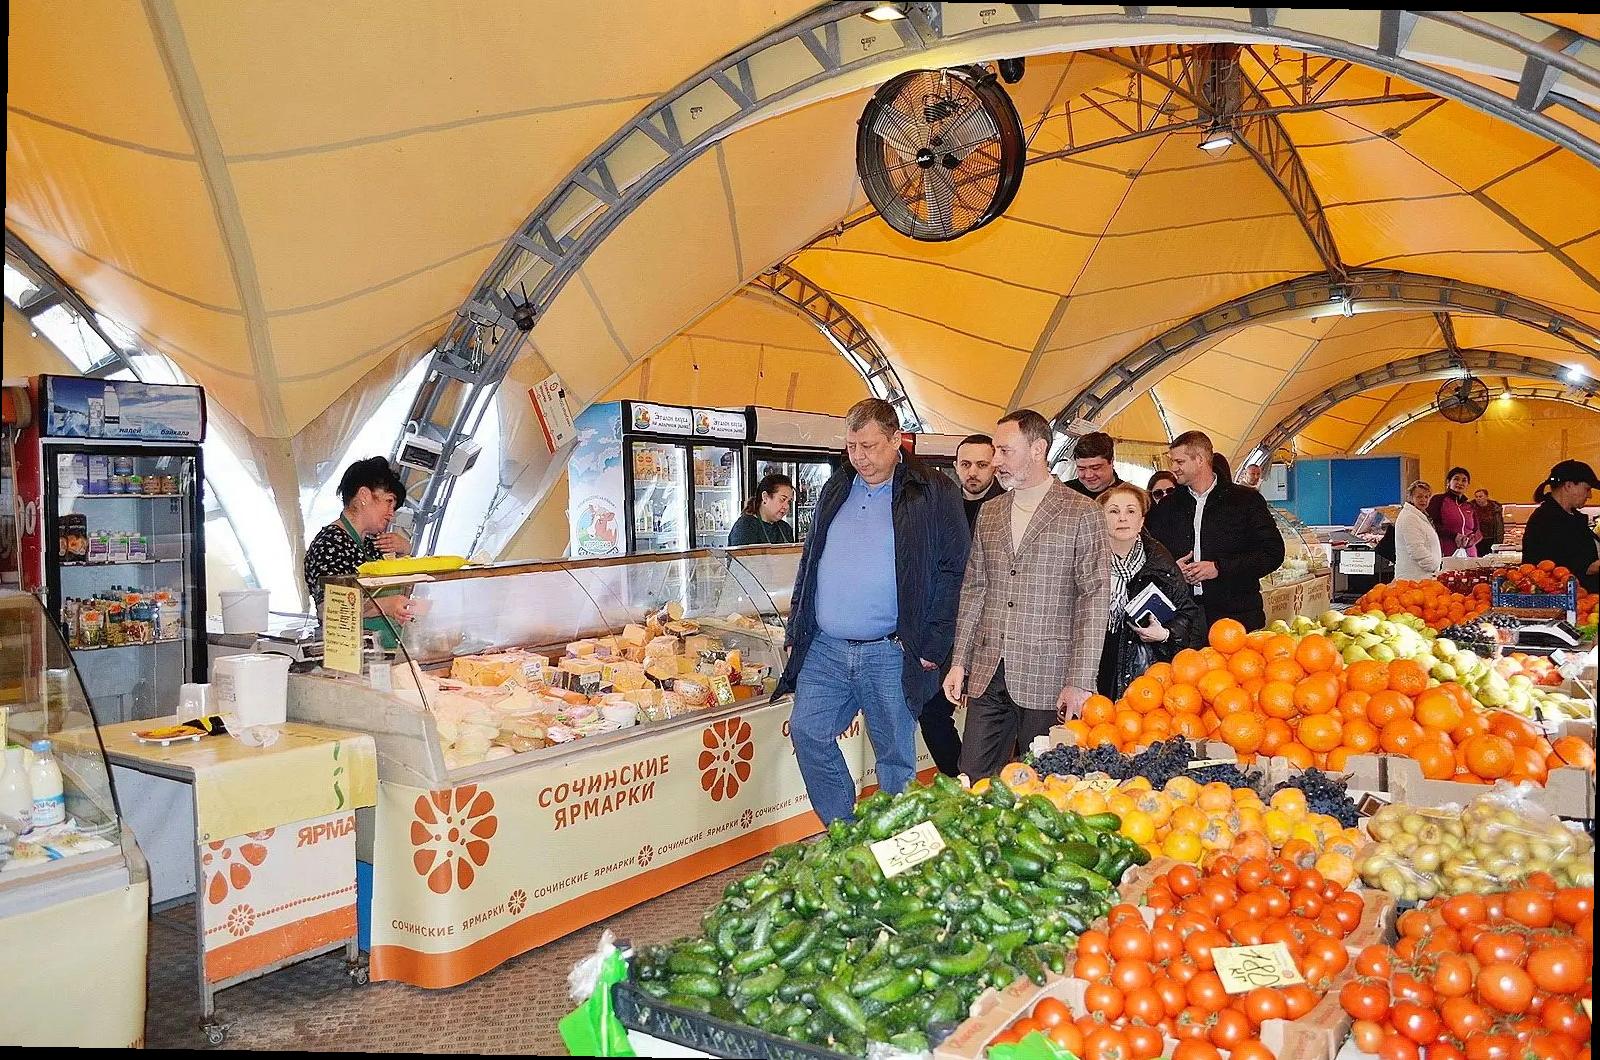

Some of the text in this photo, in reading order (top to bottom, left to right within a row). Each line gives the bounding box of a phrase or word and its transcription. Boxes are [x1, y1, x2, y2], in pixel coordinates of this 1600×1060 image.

[538, 754, 669, 808] СОЧИНСКИЕ
[554, 781, 655, 831] ЯРМАРКИ
[391, 800, 792, 937] СОЧИНСКИЕ ЯРМАРКИ СОЧИНСКИЕ ЯРМАРКИ СОЧИНСКИЕ ЯРМАРКИ СОЧИНСКИЕ
[895, 831, 930, 864] 250
[1239, 949, 1280, 986] 180
